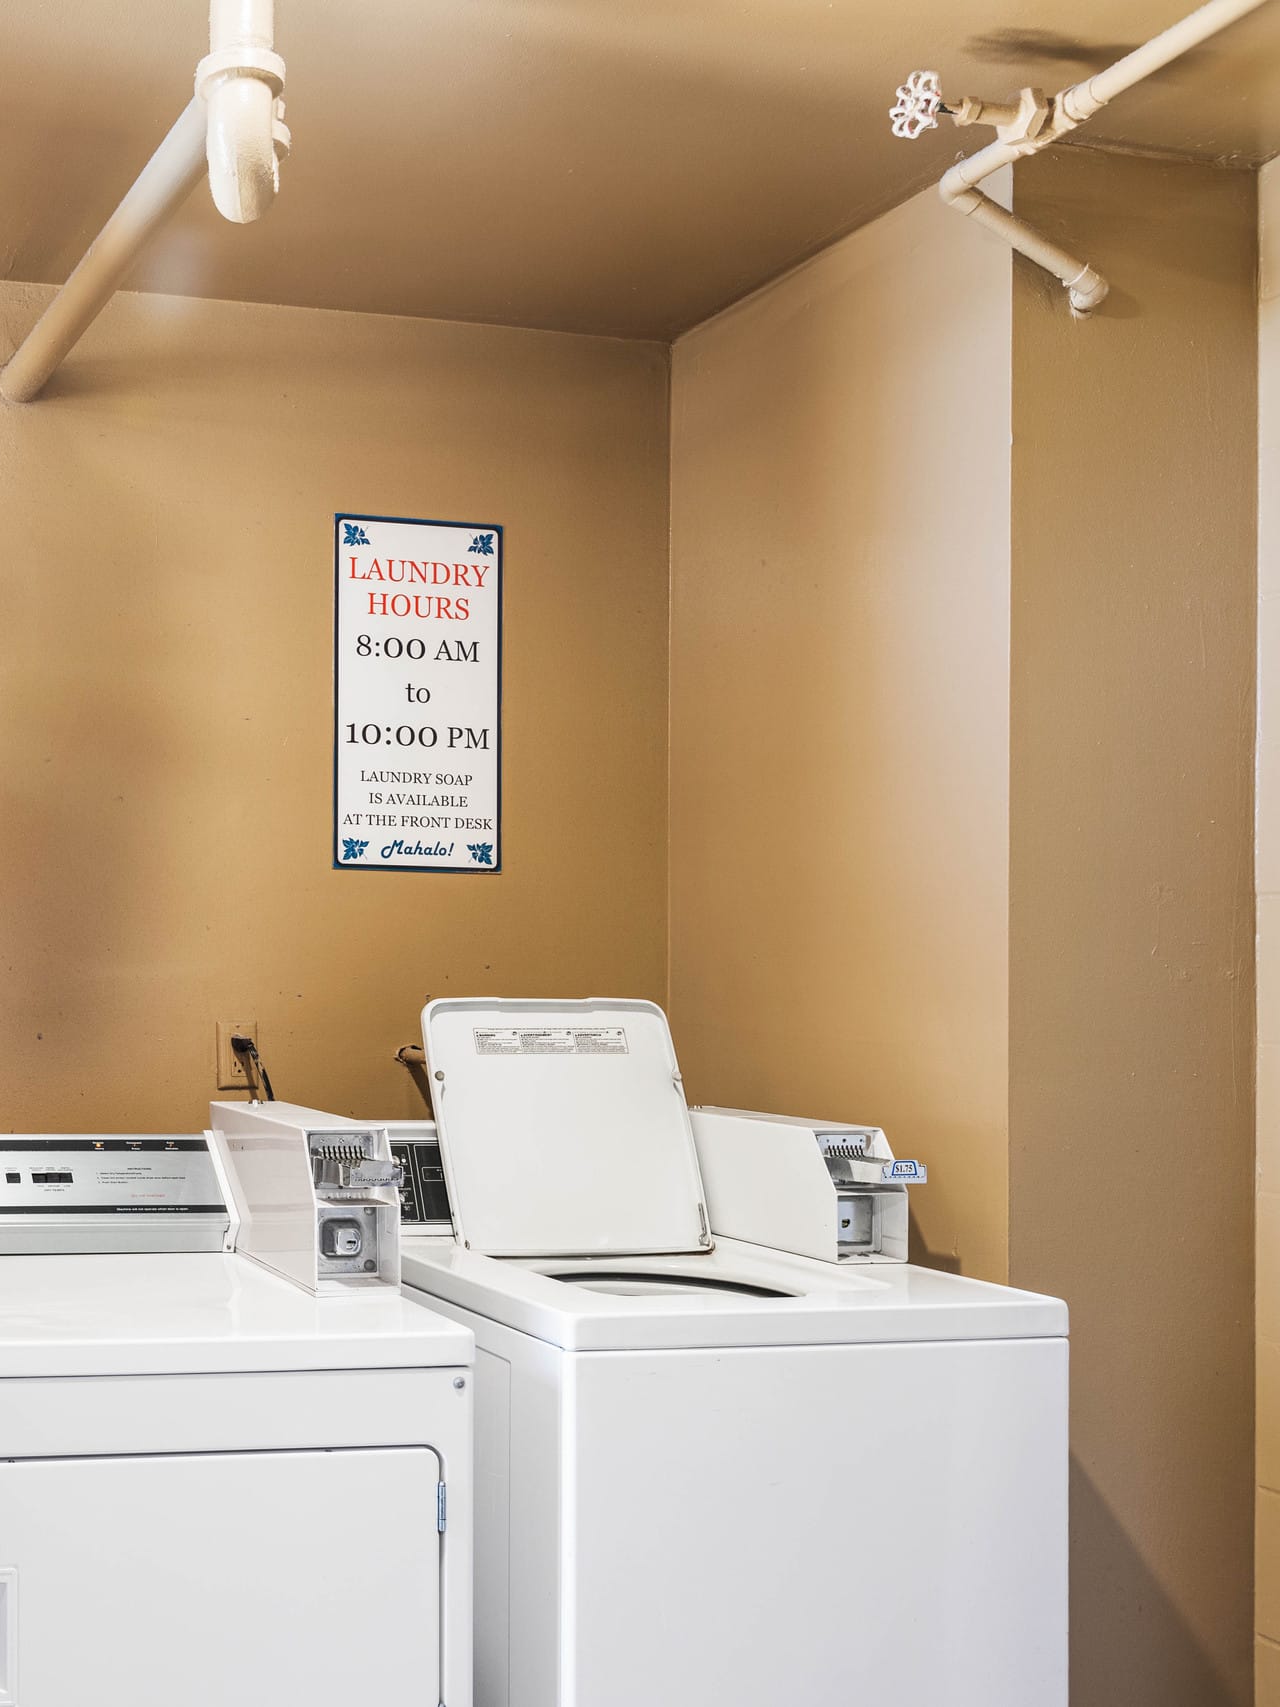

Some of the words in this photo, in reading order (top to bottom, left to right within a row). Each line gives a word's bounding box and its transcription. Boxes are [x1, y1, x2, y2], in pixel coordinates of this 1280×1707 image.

[349, 557, 490, 587] LAUNDRY
[368, 592, 470, 620] HOURS
[356, 635, 426, 660] 8:00
[434, 639, 480, 662] AM
[406, 683, 431, 703] to
[346, 723, 438, 747] 10:00
[447, 727, 490, 750] PM
[360, 770, 432, 784] LAUNDRY
[435, 773, 472, 786] SOAP
[369, 792, 383, 804] IS
[386, 794, 468, 807] AVAILABLE
[343, 813, 362, 825] AT
[366, 814, 397, 826] THE
[401, 816, 451, 828] FRONT
[455, 818, 492, 830] DESK
[381, 840, 454, 858] Mahalo!
[895, 1164, 913, 1173] $1.75
